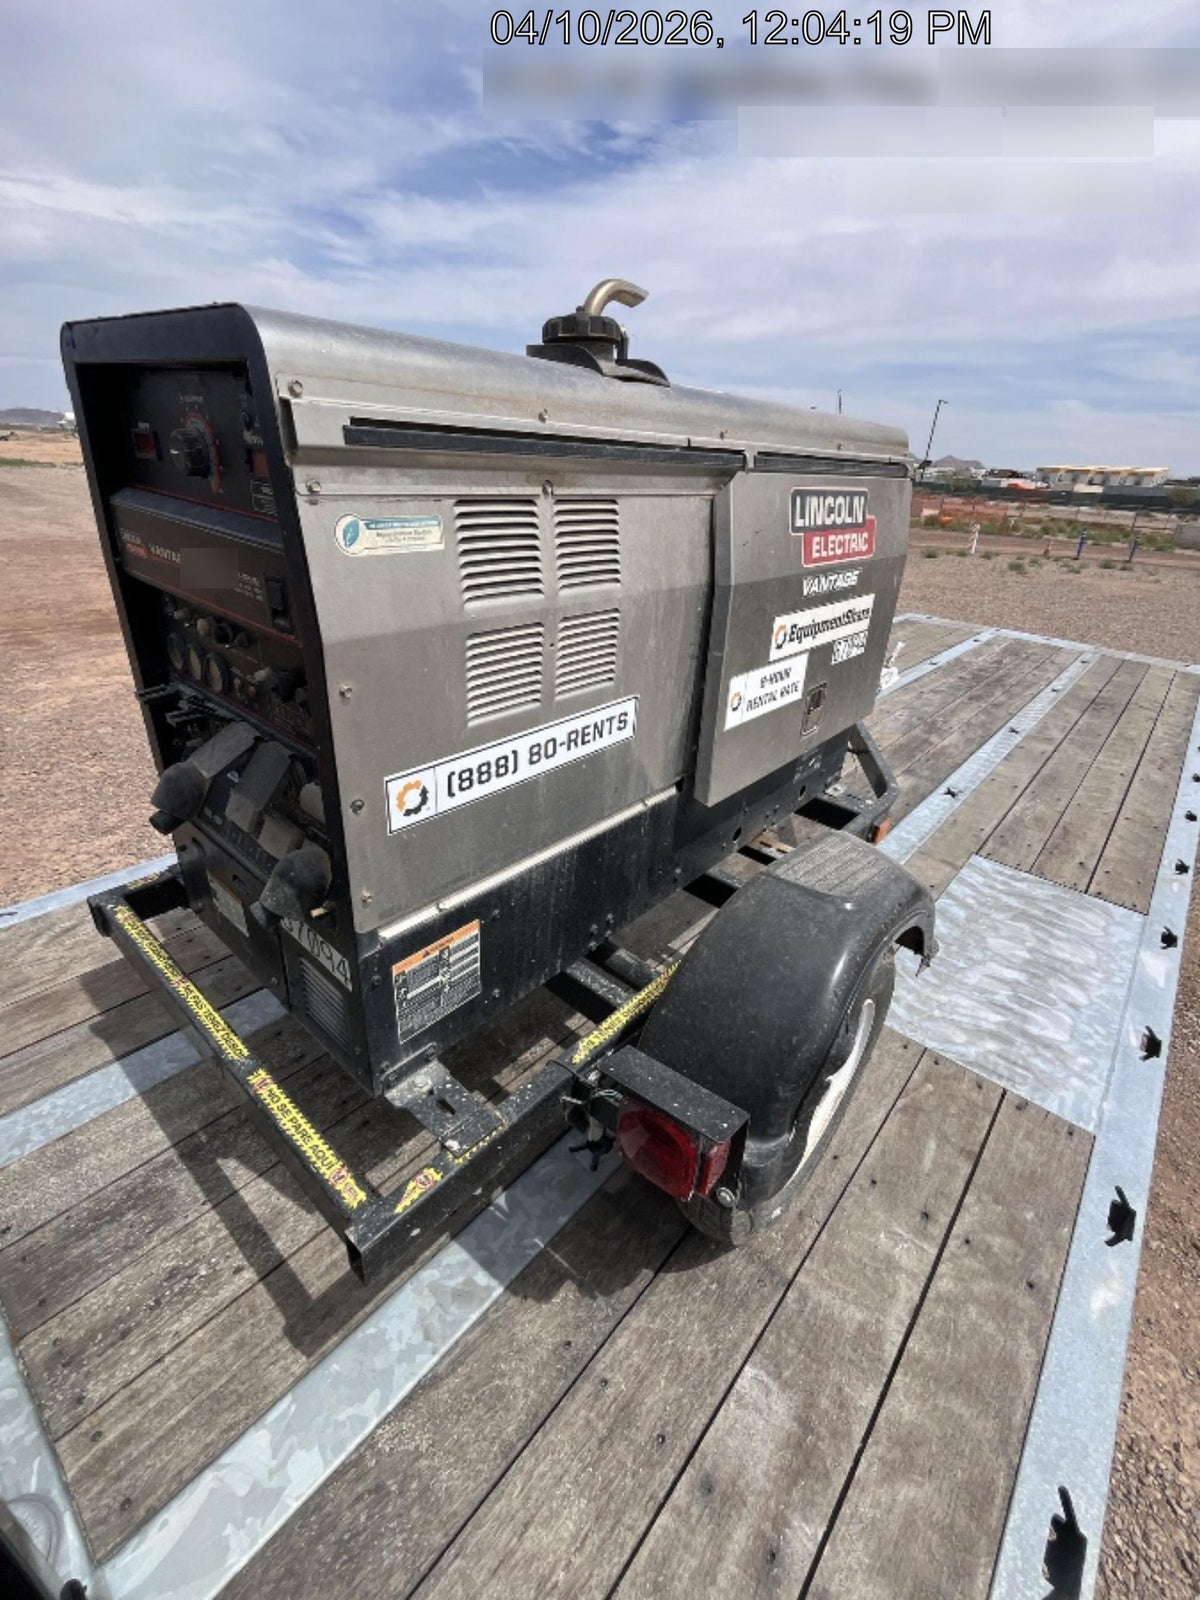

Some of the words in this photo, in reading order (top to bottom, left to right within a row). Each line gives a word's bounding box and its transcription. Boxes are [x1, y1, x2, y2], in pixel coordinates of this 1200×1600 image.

[795, 496, 865, 527] LINCOLN
[812, 532, 869, 559] ELECTRIC
[802, 570, 860, 596] VANTAGE
[788, 607, 870, 644] EquipmentShare
[447, 750, 518, 797] (888)
[528, 712, 628, 765] 80-RENTS
[277, 1103, 292, 1118] SE
[289, 1116, 314, 1145] PARE
